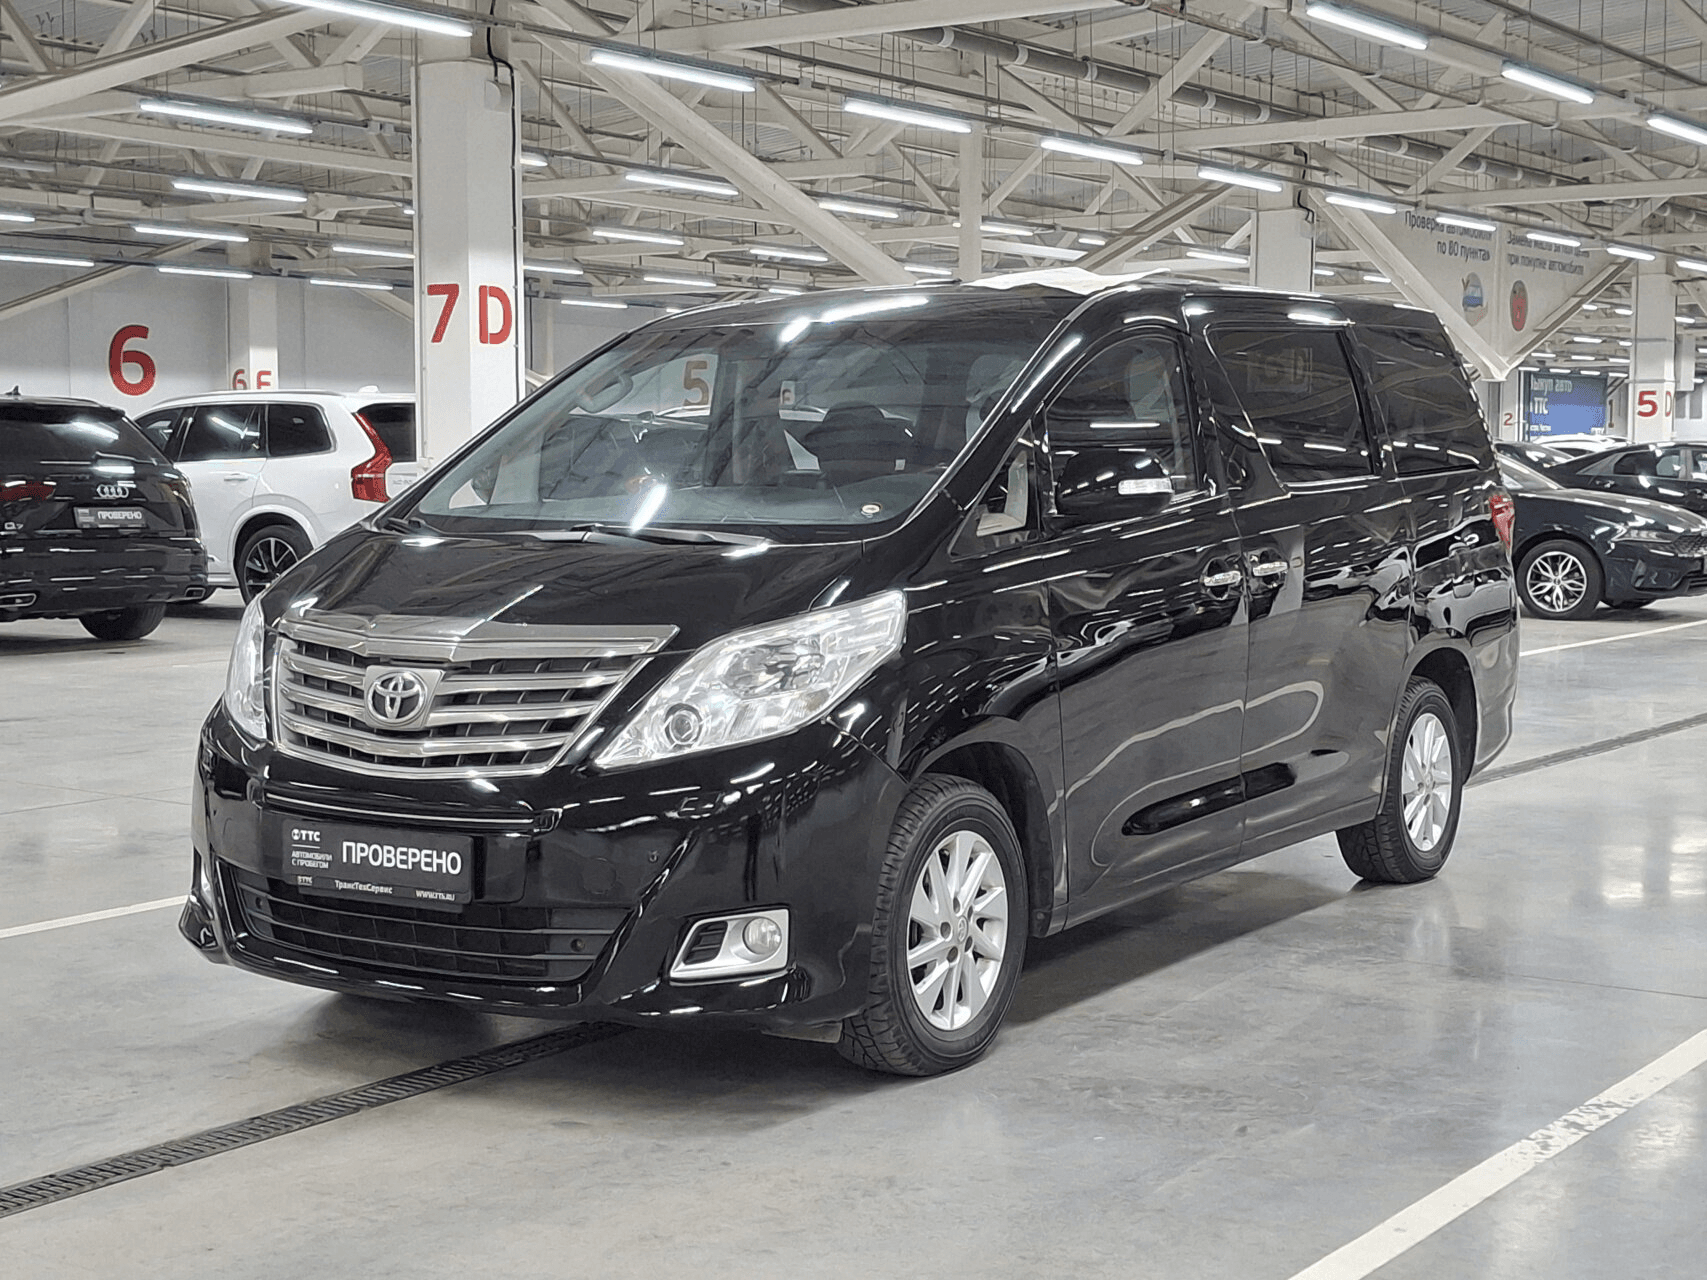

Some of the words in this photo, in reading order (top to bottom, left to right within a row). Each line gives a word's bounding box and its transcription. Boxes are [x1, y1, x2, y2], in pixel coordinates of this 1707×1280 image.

[1437, 241, 1447, 255] по
[1449, 240, 1459, 257] 80
[427, 283, 459, 344] 7
[479, 285, 512, 345] D
[108, 324, 156, 396] 6
[232, 369, 248, 390] 6
[683, 360, 709, 411] 5
[1637, 390, 1658, 418] 5
[1503, 412, 1514, 426] 2
[97, 511, 143, 520] ПРОВЕРЕНО
[300, 829, 321, 842] ТТС
[291, 850, 333, 862] АВТОМОБИЛИ
[291, 858, 297, 866] С
[297, 859, 329, 869] ПРОБЕГОМ
[342, 841, 462, 875] ПРОВЕРЕНО
[334, 879, 393, 894] ТрансТехСервис
